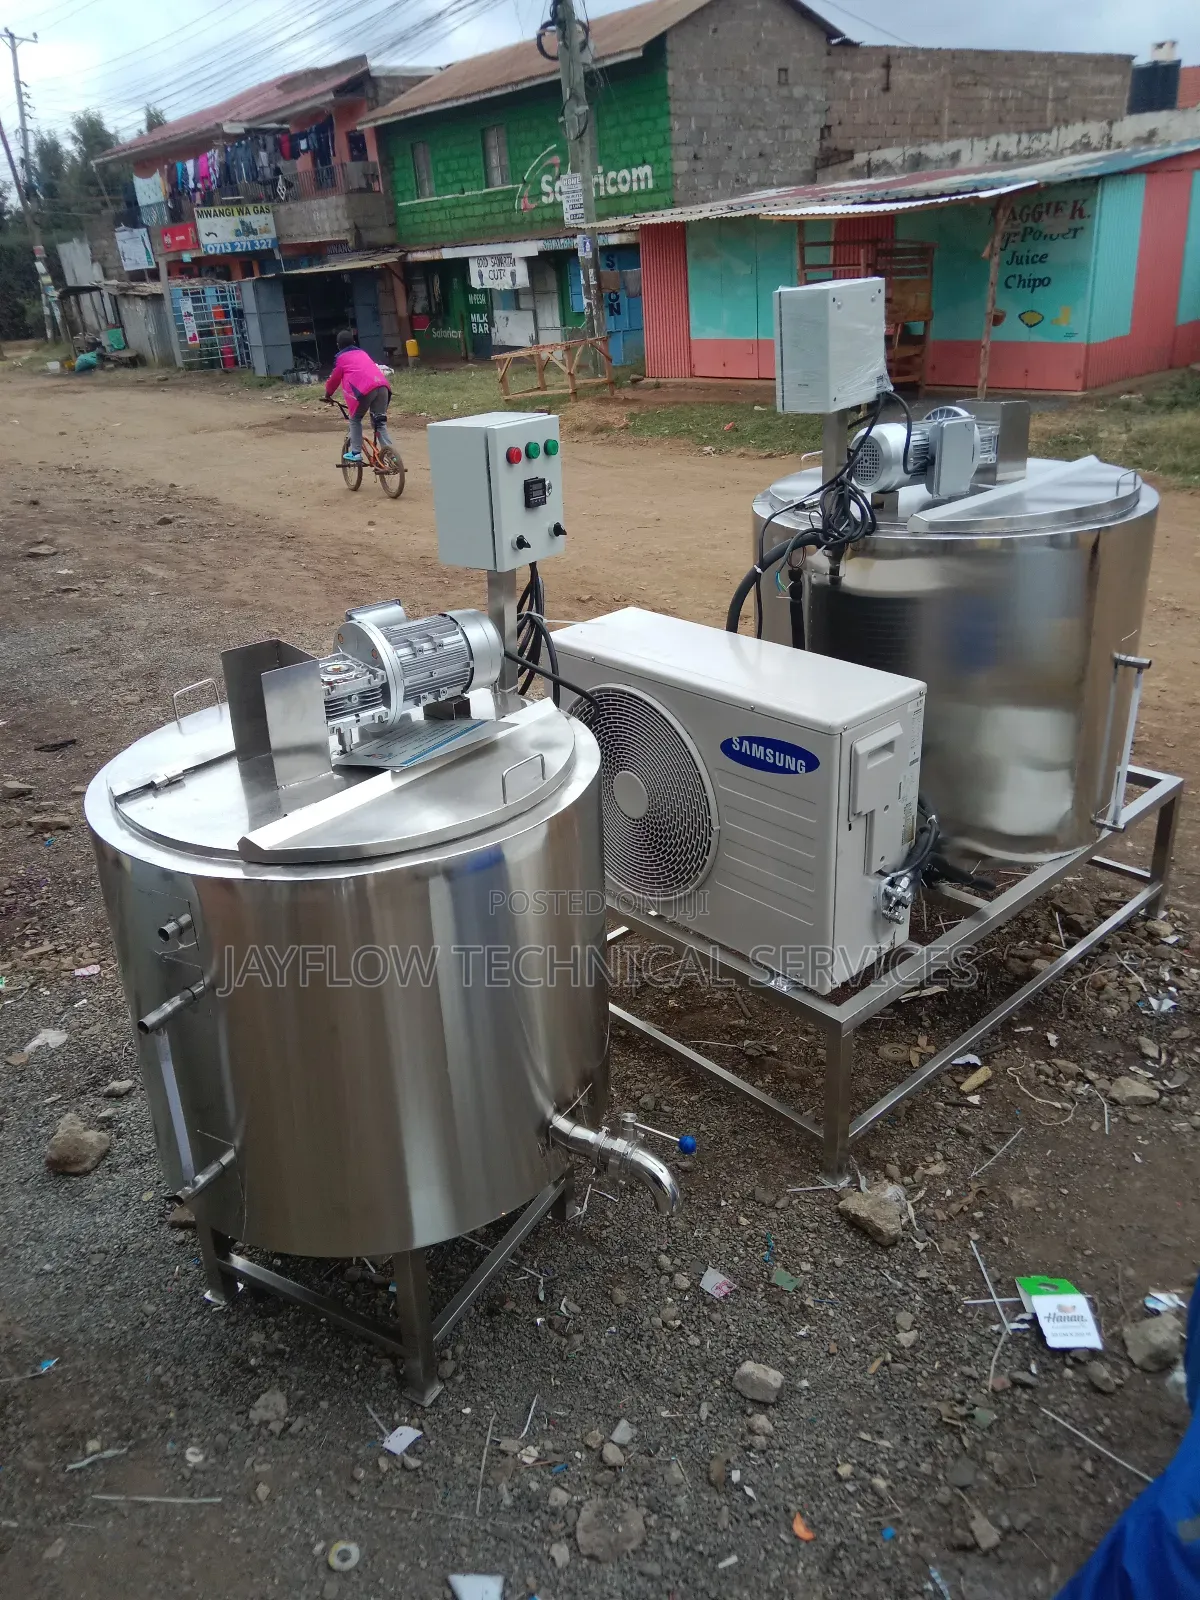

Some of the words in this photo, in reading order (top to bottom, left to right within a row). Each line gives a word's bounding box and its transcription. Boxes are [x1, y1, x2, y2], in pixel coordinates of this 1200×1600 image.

[196, 207, 235, 219] MWANGI
[236, 207, 252, 217] WA
[253, 205, 271, 215] GAS
[206, 242, 232, 254] 0713
[233, 241, 251, 252] 271
[254, 239, 272, 250] 327
[1006, 250, 1049, 266] Juice
[1004, 273, 1052, 294] Chipo
[470, 313, 489, 323] MILK
[471, 322, 490, 334] BAR
[731, 736, 806, 775] SAMSUNG
